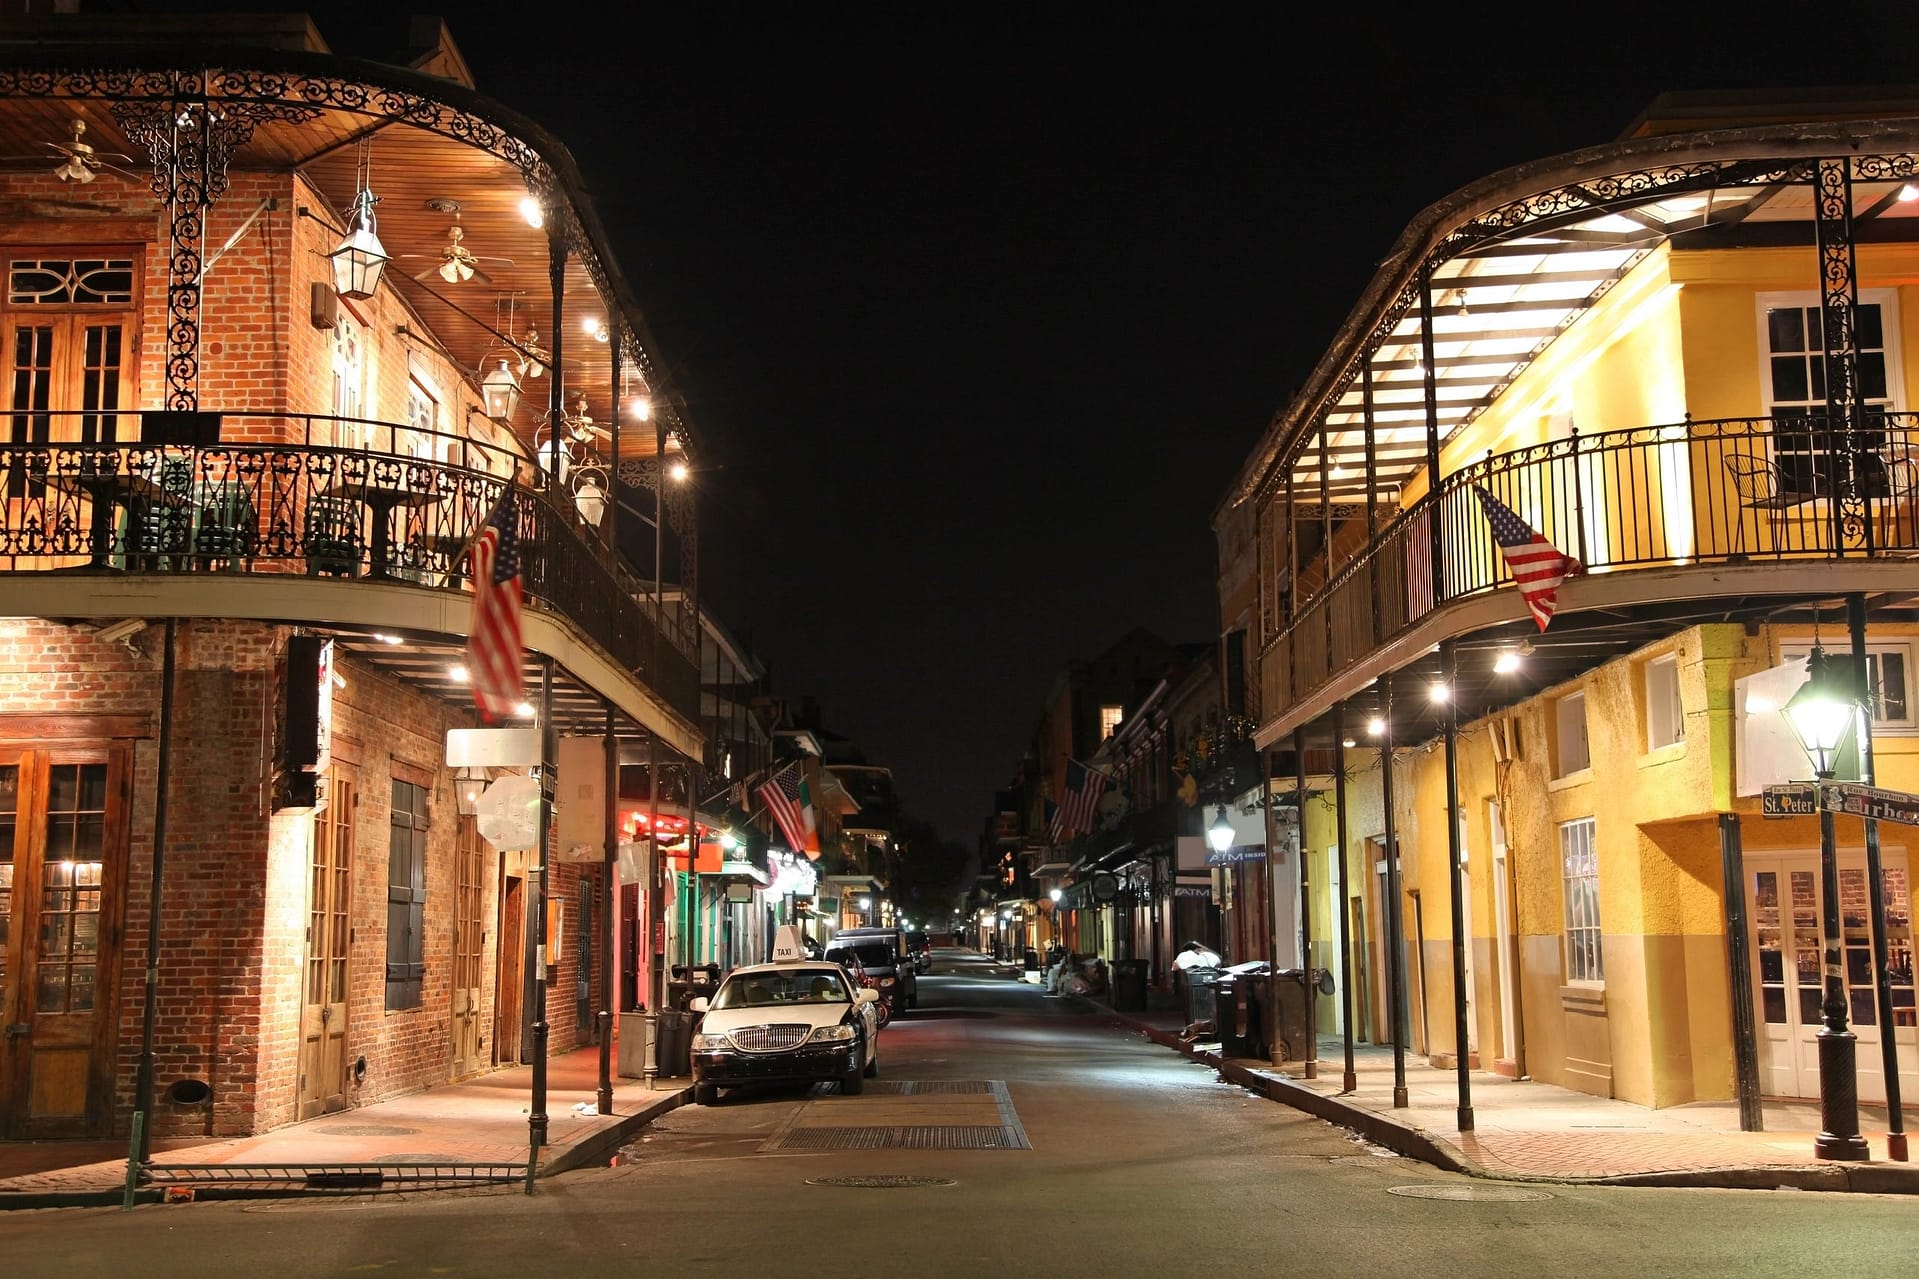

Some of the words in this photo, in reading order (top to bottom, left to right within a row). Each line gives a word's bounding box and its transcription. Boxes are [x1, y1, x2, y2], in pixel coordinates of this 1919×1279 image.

[1765, 797, 1780, 812] St.
[1782, 796, 1812, 812] Peter
[1209, 853, 1243, 862] ATM
[1179, 888, 1209, 896] ATM
[776, 948, 792, 956] TAXI
